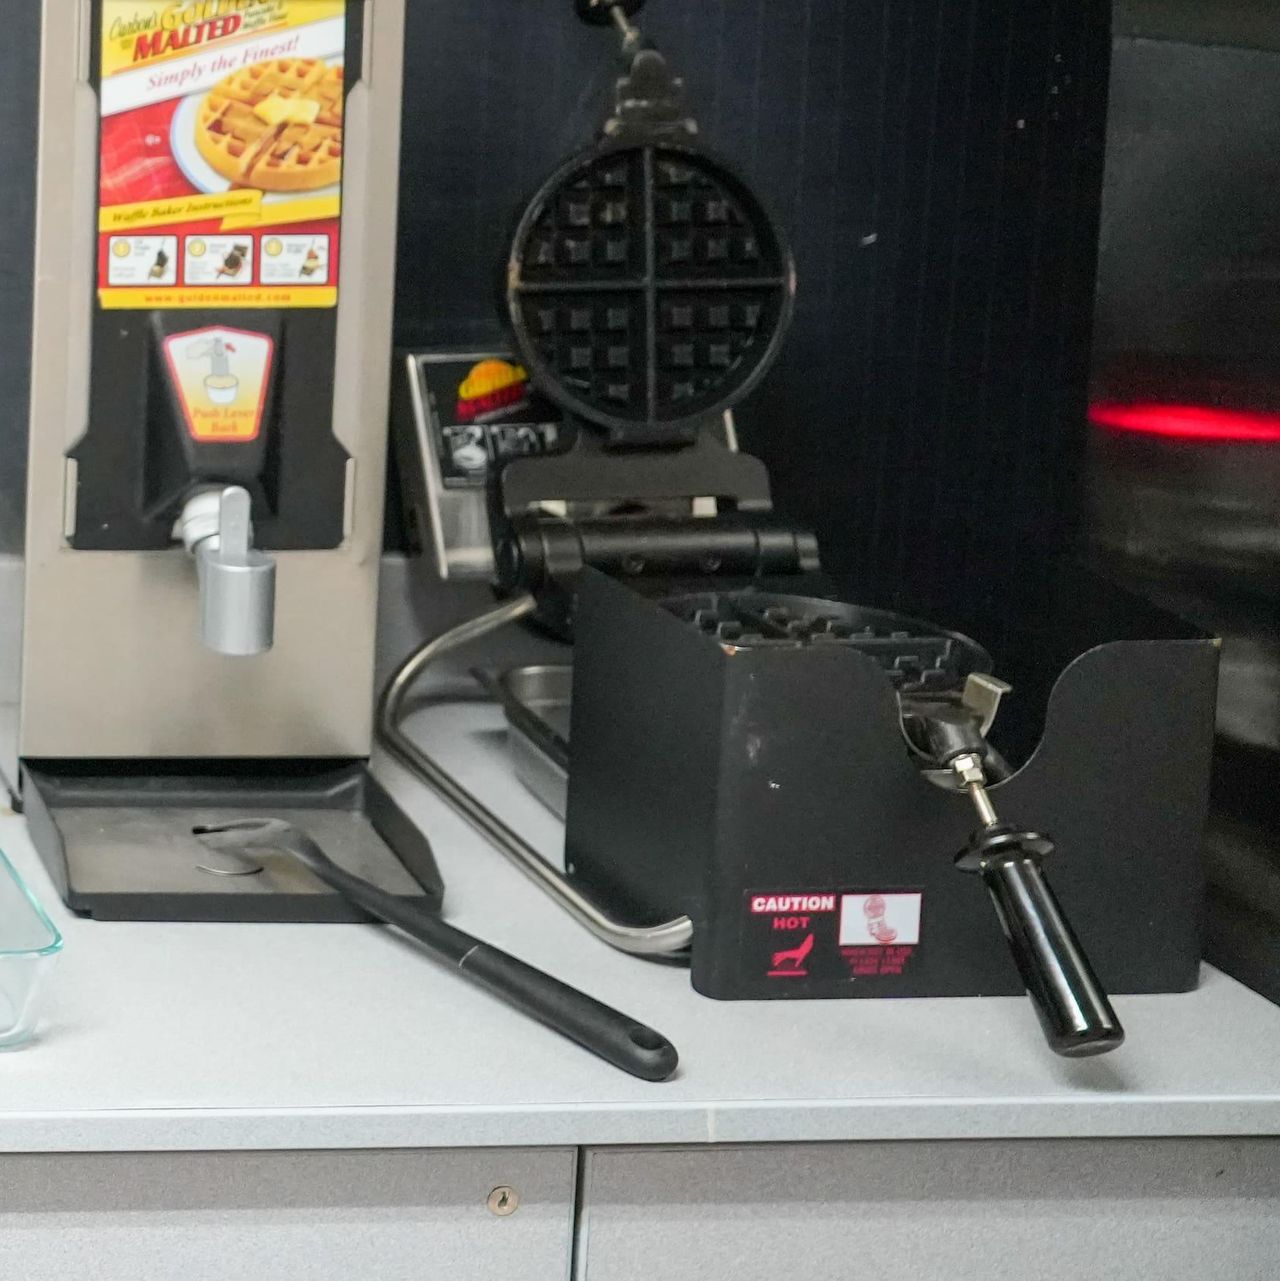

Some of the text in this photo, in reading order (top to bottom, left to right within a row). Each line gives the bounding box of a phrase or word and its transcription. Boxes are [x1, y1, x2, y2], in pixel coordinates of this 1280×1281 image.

[133, 14, 242, 62] MALTED
[148, 34, 300, 89] Simply the Finest!
[751, 897, 835, 911] CAUTION
[773, 918, 810, 929] HOT
